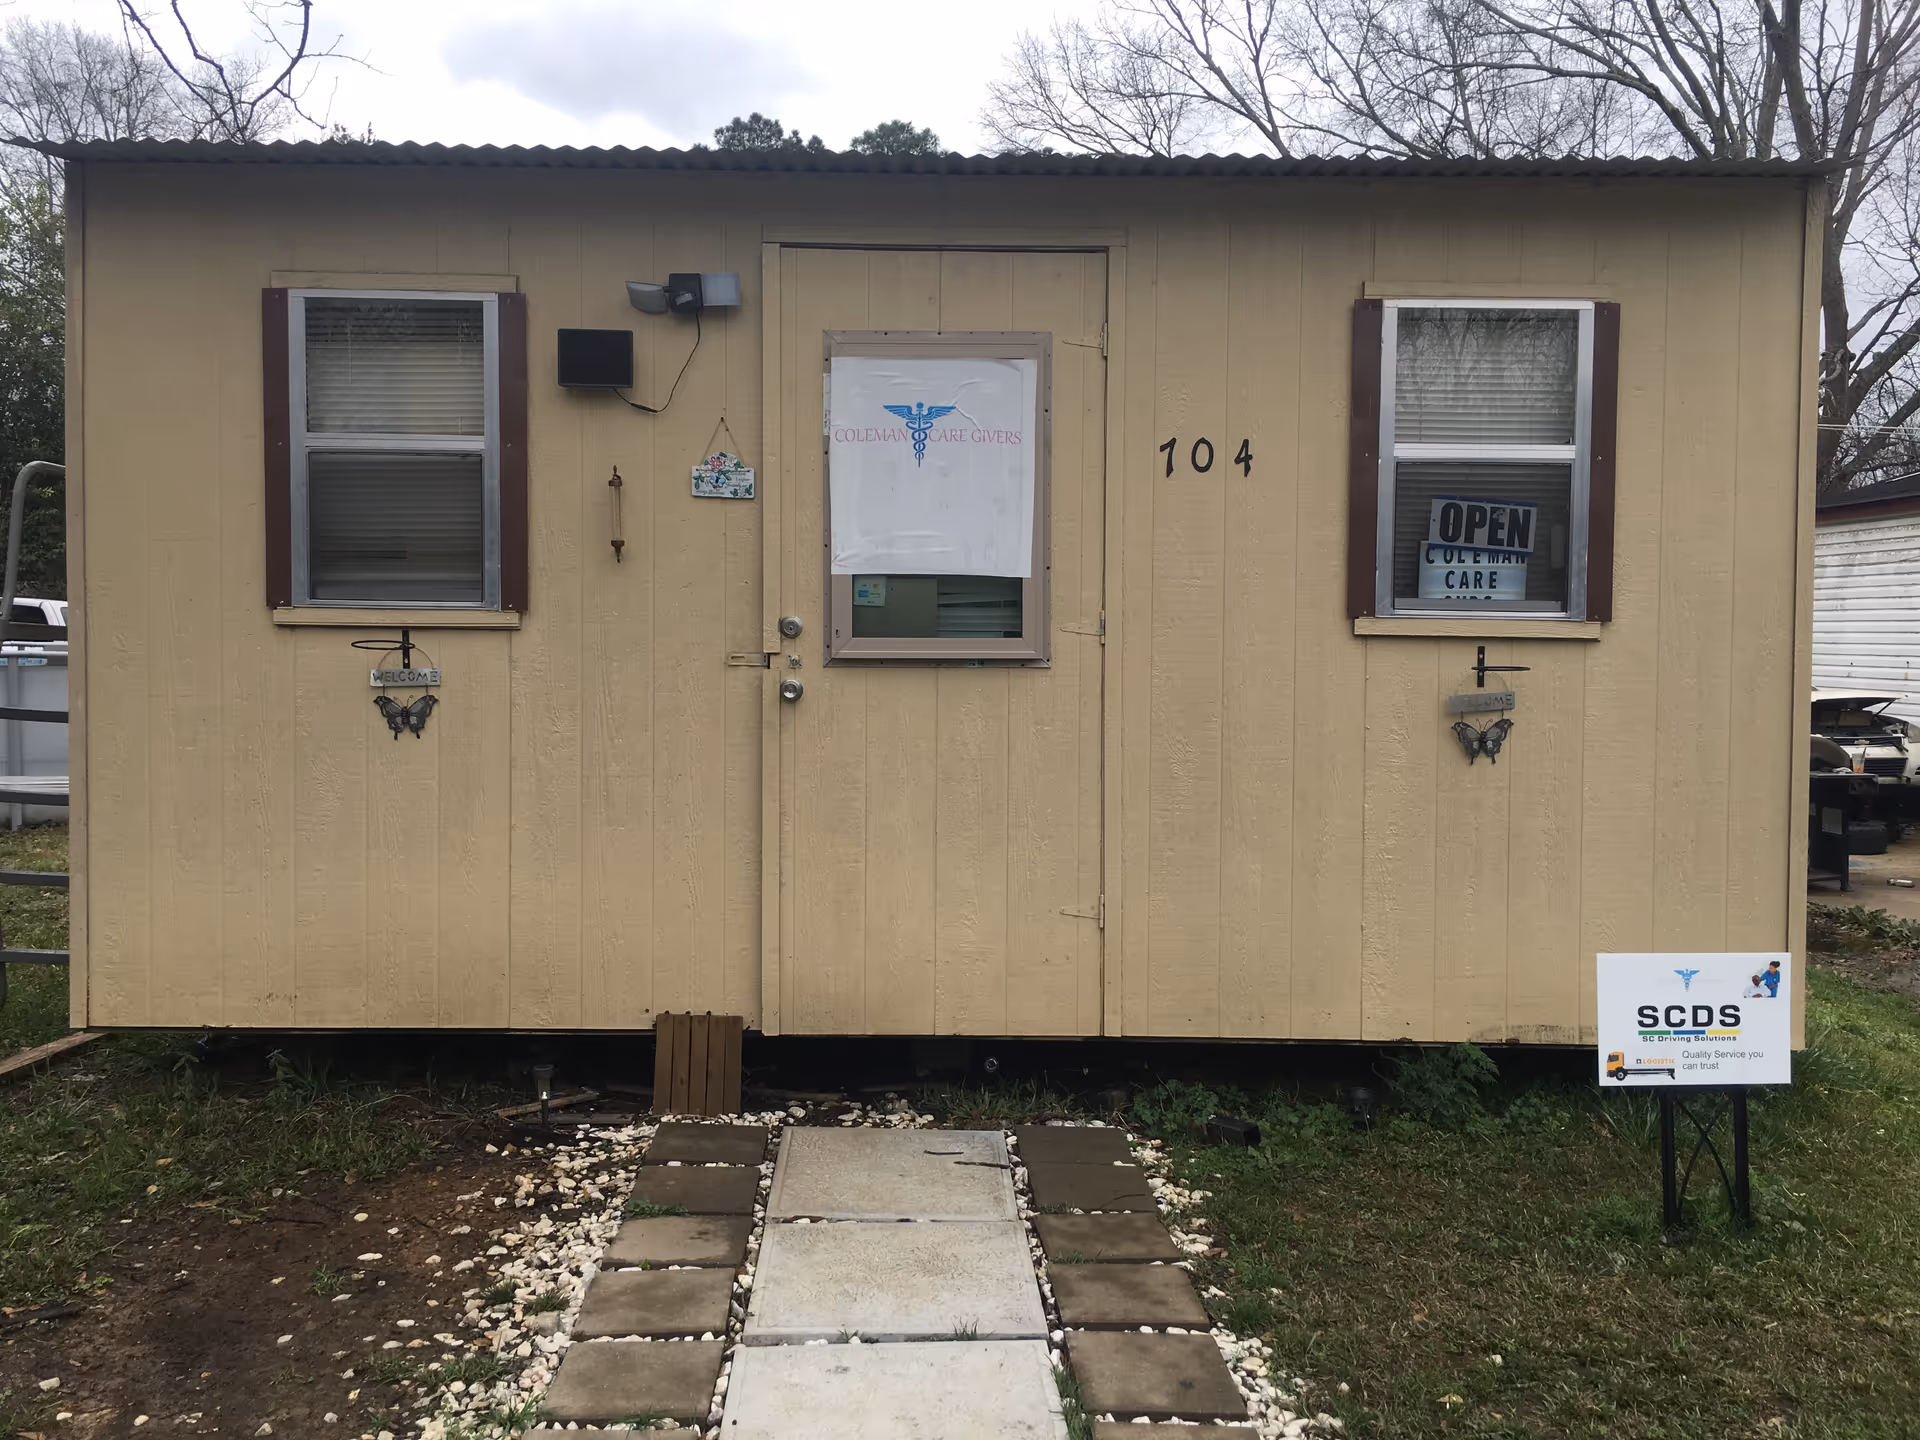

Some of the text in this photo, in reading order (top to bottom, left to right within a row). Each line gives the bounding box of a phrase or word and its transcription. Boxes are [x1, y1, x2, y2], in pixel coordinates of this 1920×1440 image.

[834, 428, 1022, 445] COLEMAN CARE GIVERS
[1160, 437, 1253, 478] 104
[1439, 501, 1532, 549] OPEN
[1425, 547, 1526, 564] COLEMAN
[1445, 570, 1498, 589] CARE
[372, 671, 438, 683] WELCOME
[1637, 1004, 1741, 1028] SCDS
[1658, 1035, 1691, 1043] Driving
[1682, 1049, 1764, 1060] Quality Service you
[1682, 1061, 1719, 1070] can trust
